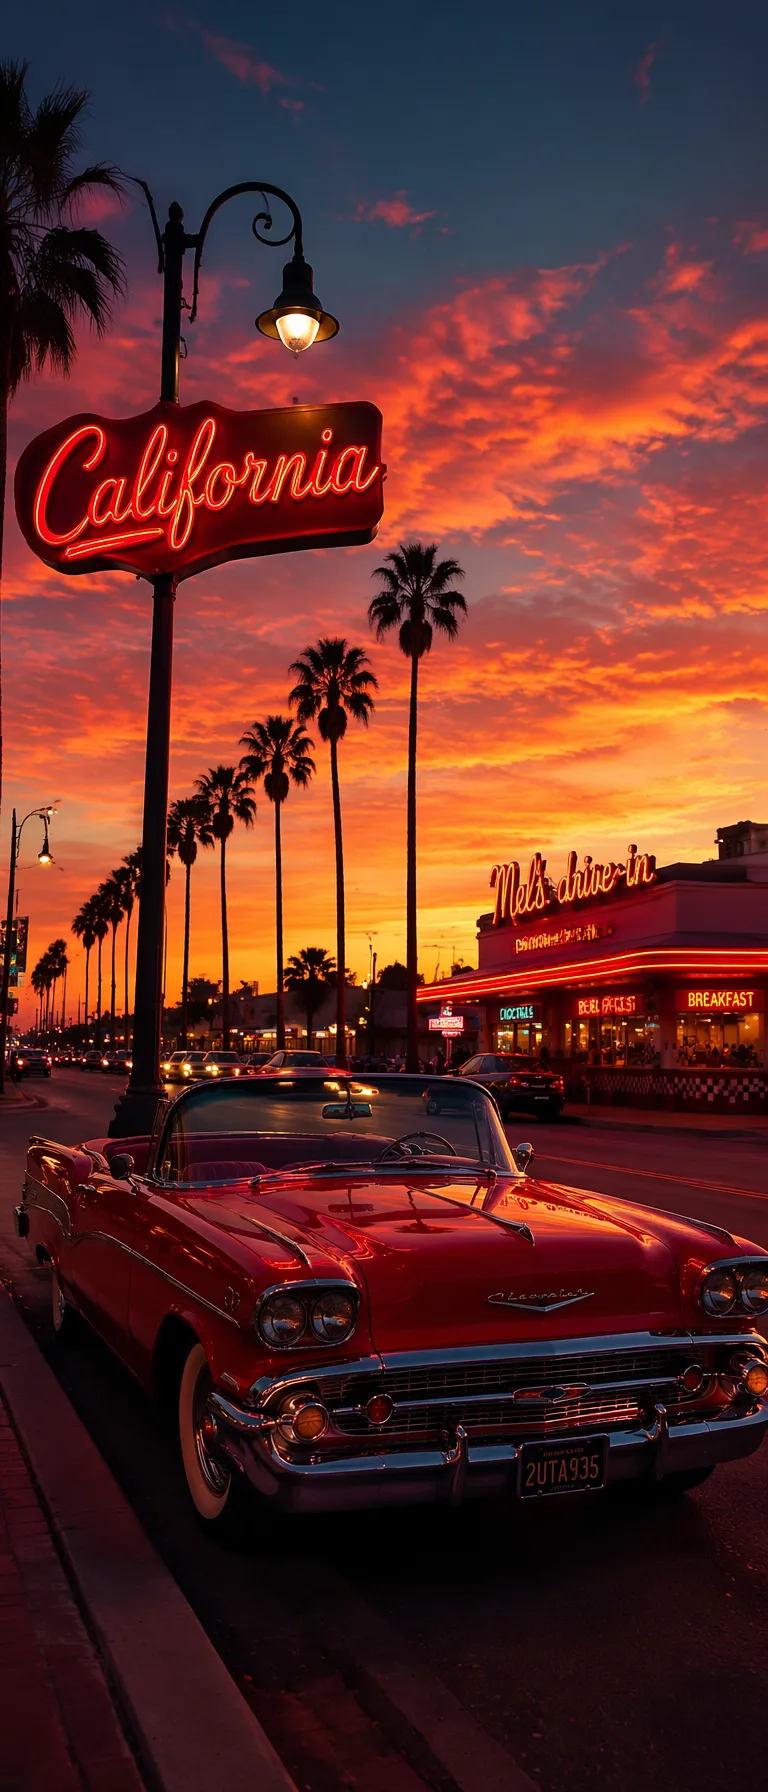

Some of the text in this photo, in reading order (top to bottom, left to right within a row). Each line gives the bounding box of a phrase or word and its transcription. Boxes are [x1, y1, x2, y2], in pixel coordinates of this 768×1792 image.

[34, 417, 379, 551] California
[688, 991, 754, 1007] BREAKFAST
[525, 1454, 599, 1487] 2UTA935
